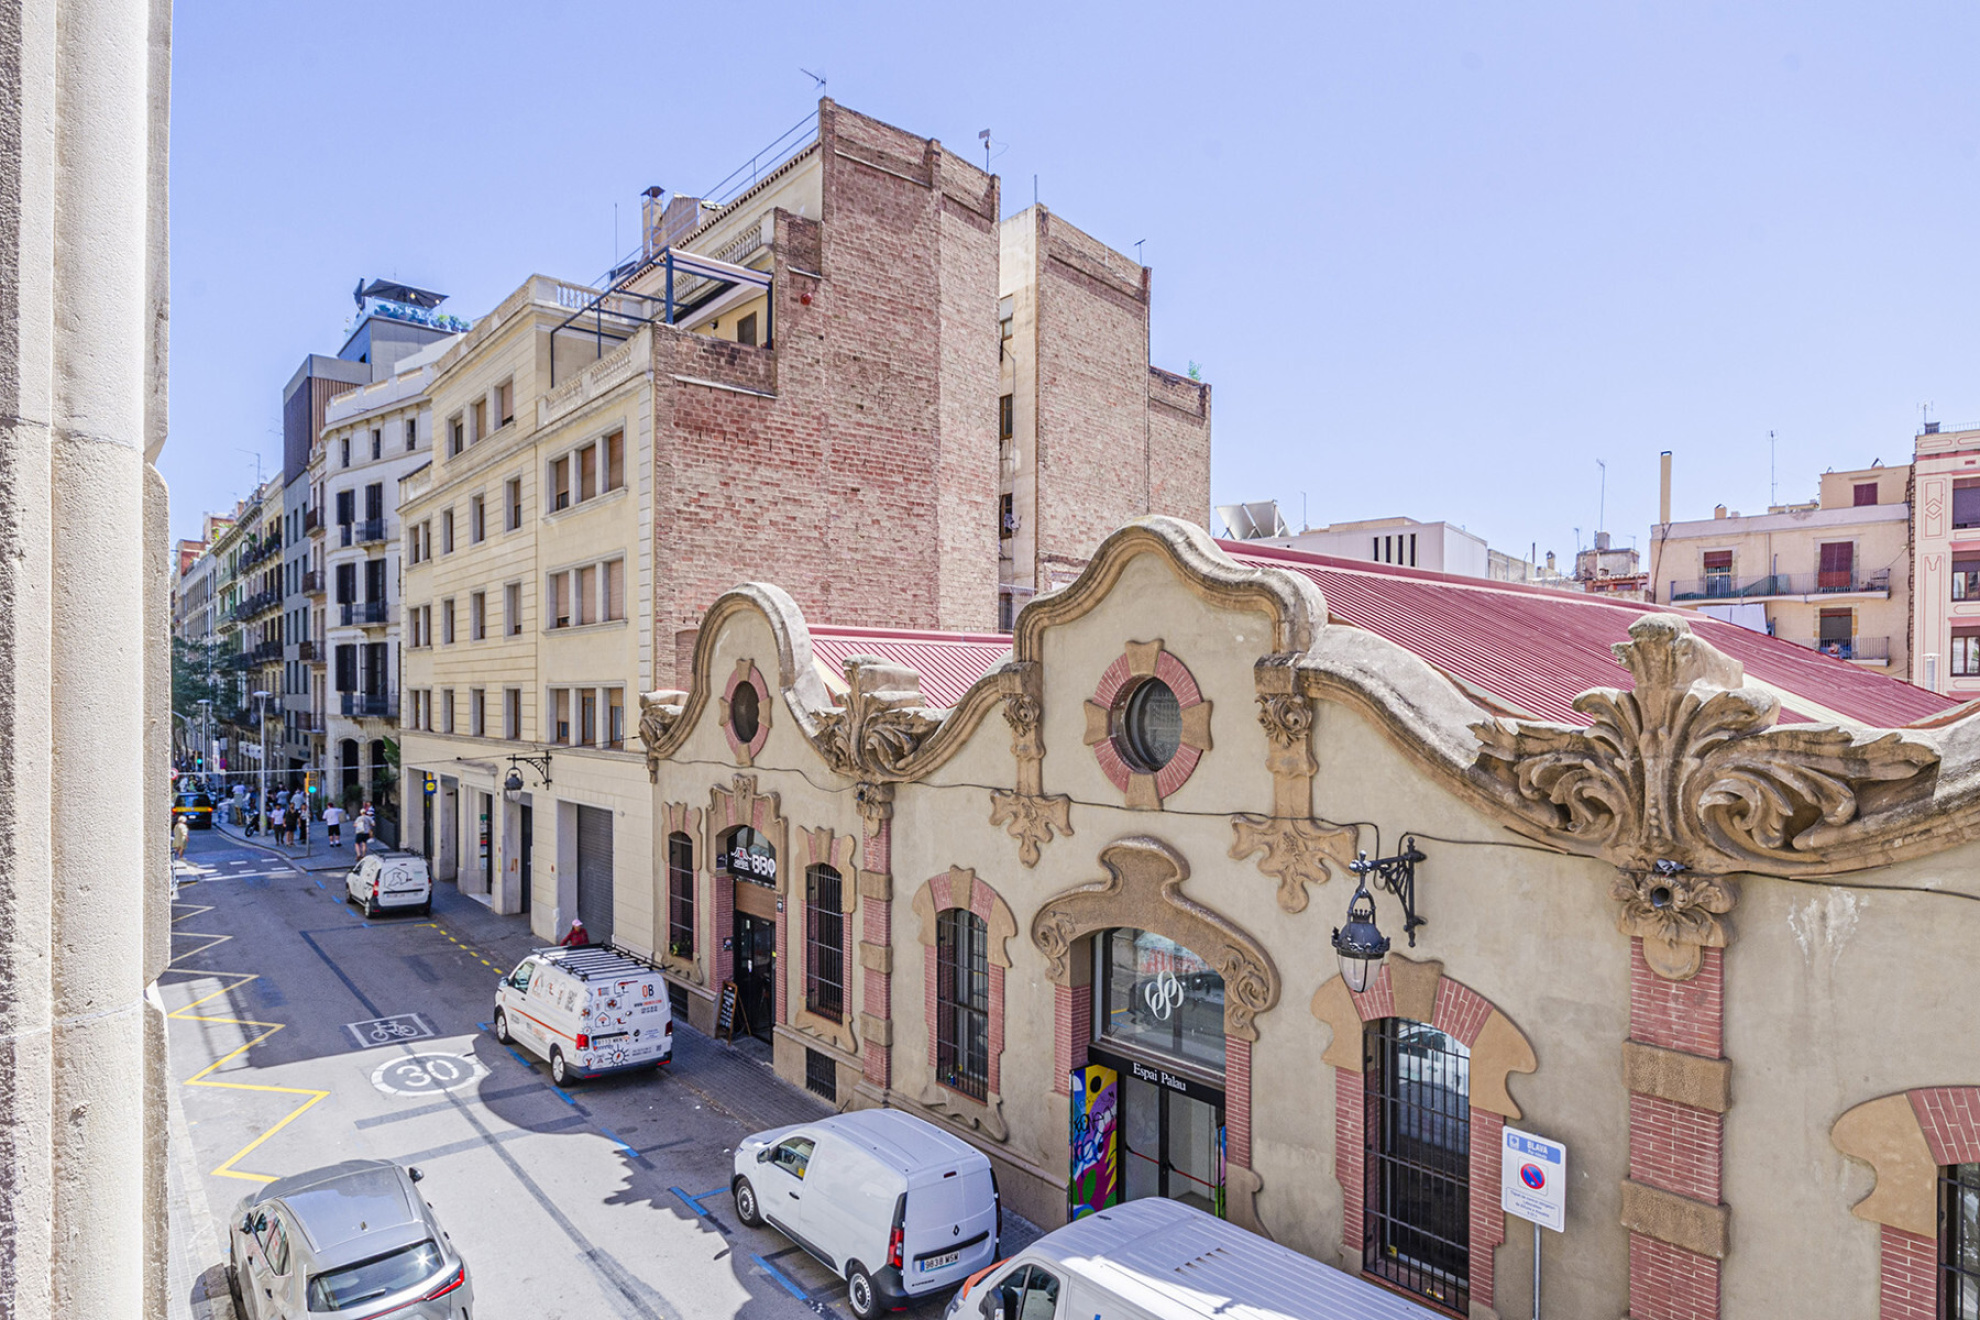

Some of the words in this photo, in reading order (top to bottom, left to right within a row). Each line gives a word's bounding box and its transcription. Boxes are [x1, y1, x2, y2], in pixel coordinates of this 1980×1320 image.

[752, 854, 776, 877] BBQ
[396, 1059, 460, 1087] 30
[1133, 1062, 1158, 1082] Espai
[1161, 1072, 1186, 1091] Palau
[1527, 1141, 1549, 1155] BLAVA
